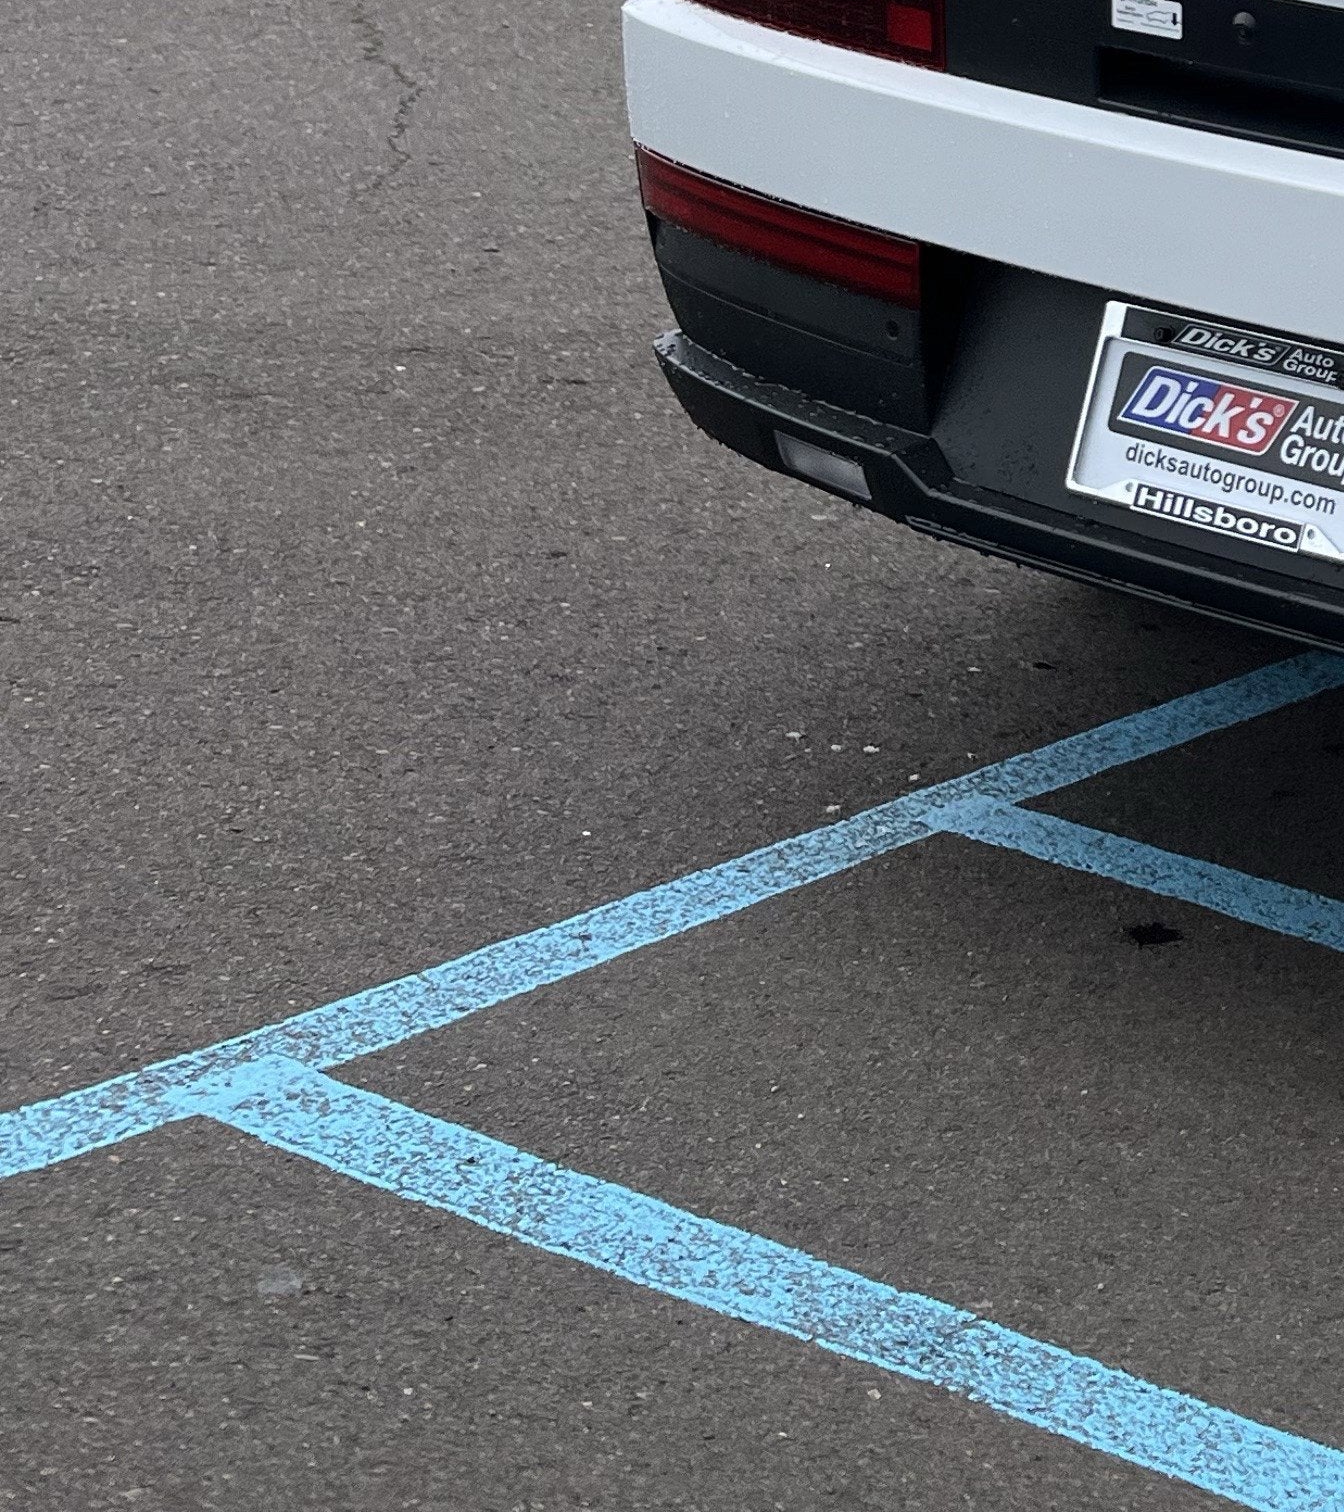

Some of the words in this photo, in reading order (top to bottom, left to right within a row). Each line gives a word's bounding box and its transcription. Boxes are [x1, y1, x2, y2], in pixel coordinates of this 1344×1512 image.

[1181, 327, 1277, 362] Dick's
[1288, 348, 1336, 368] Auto
[1132, 374, 1276, 446] Dick's
[1125, 442, 1336, 515] dicksautogroup.com
[1134, 485, 1298, 546] Hillsboro
